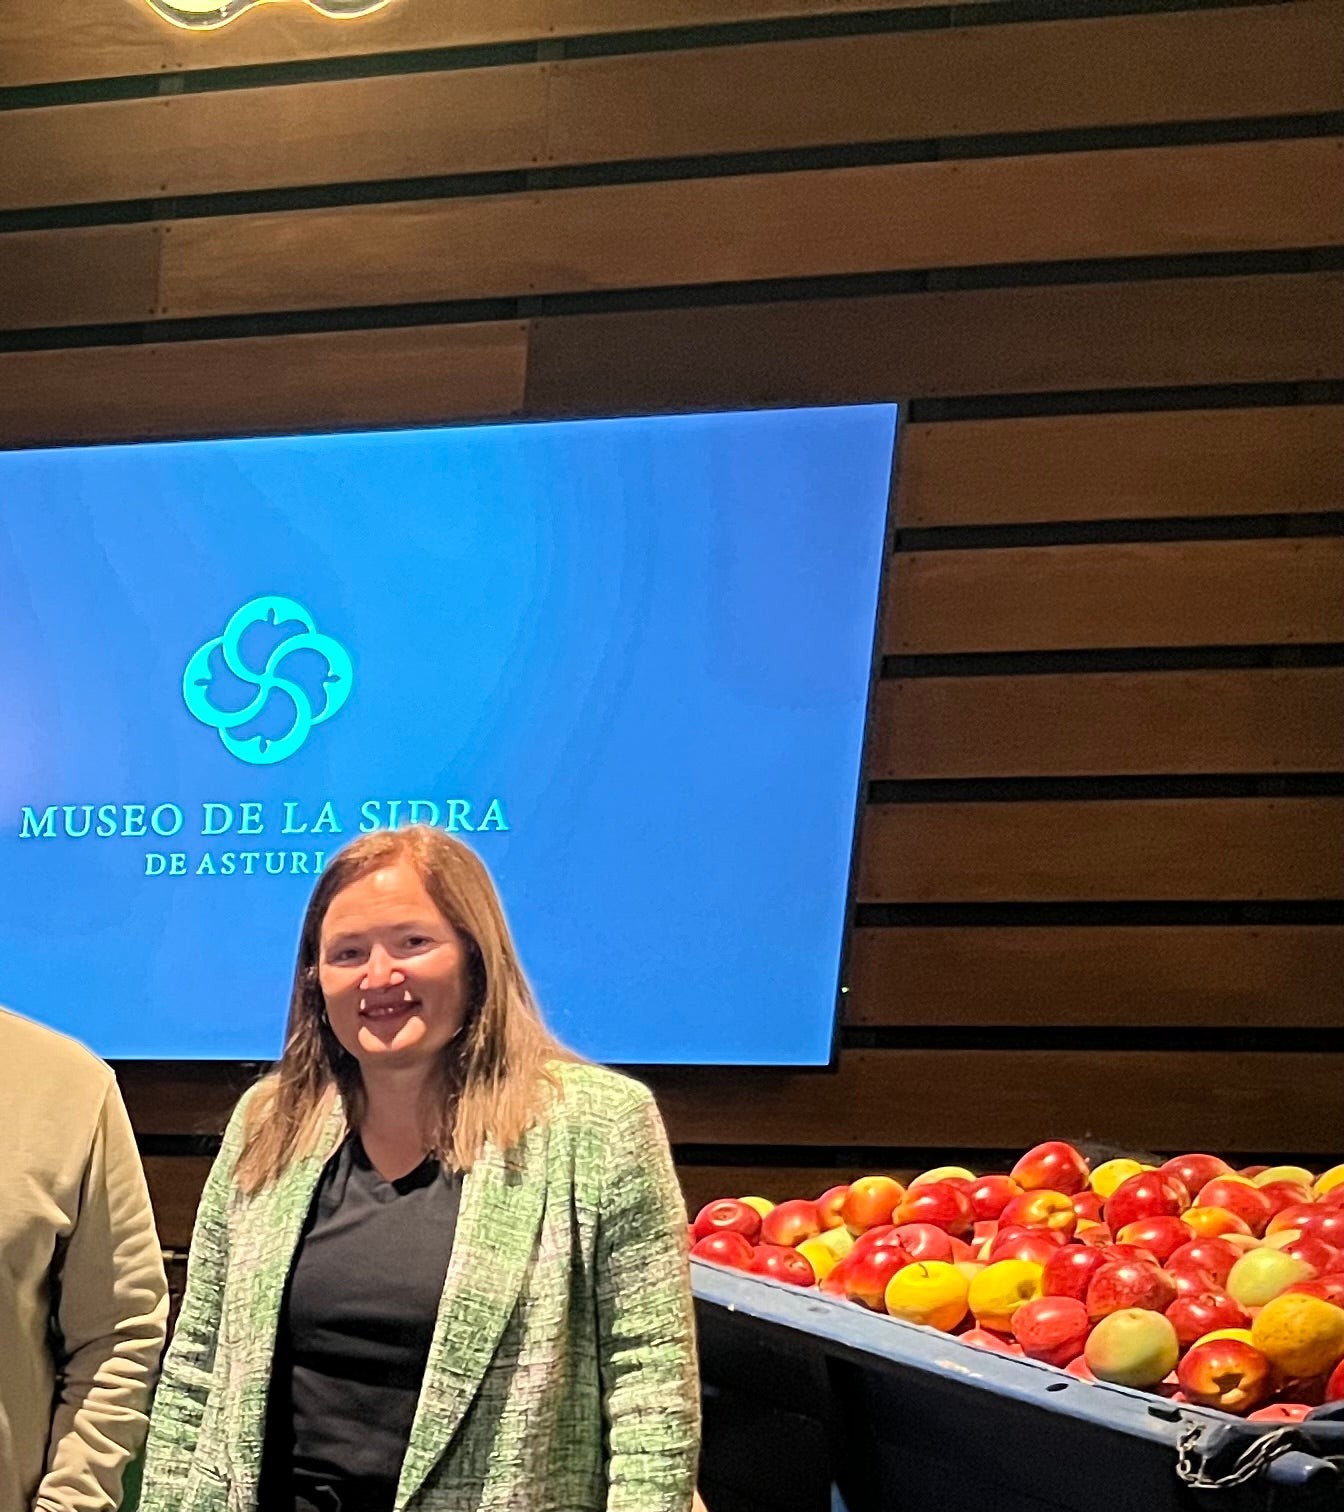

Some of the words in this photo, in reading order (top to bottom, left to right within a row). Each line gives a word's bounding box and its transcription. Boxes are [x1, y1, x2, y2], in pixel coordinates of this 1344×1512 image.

[18, 803, 184, 838] MUSEO
[200, 802, 265, 836] DE
[281, 800, 344, 834] LA
[359, 798, 510, 833] SIDRA
[144, 853, 187, 876] DE
[196, 851, 325, 875] ASTURI
